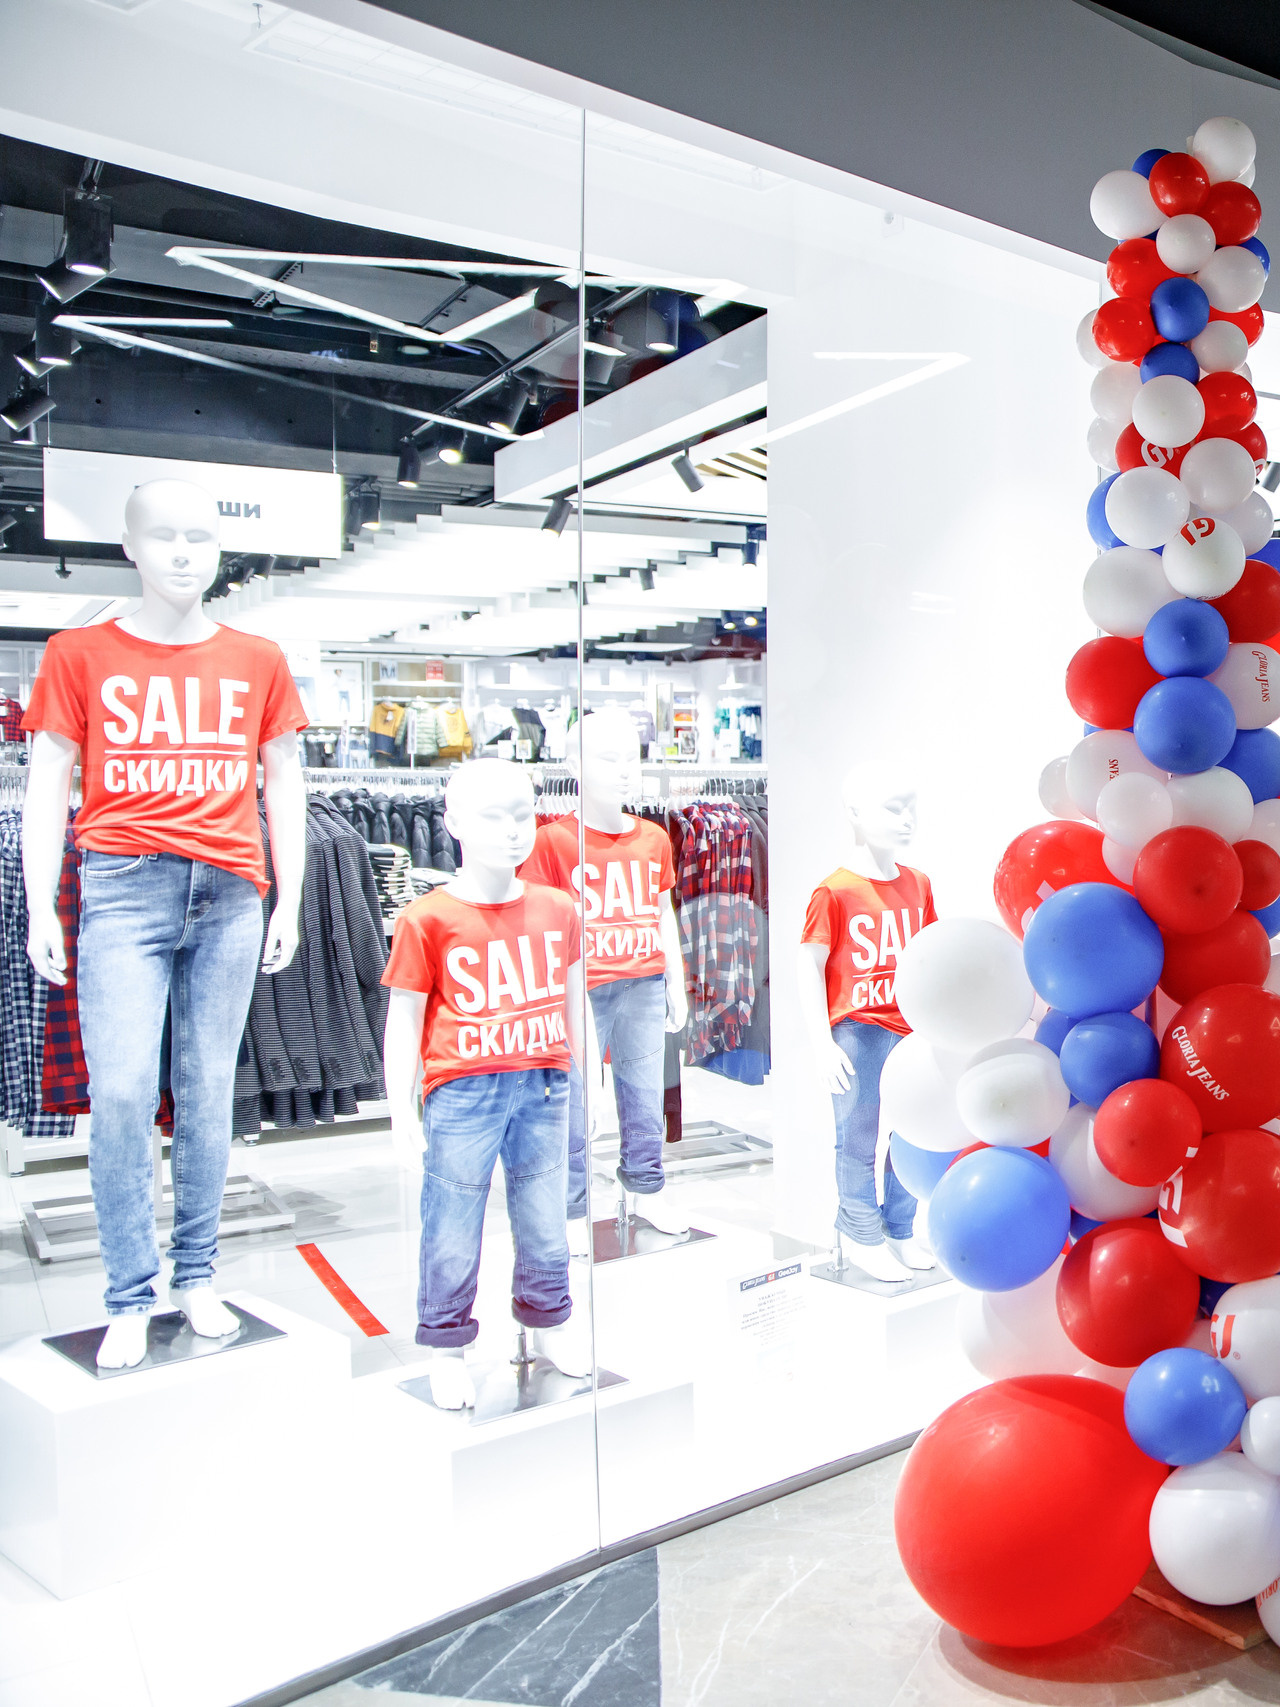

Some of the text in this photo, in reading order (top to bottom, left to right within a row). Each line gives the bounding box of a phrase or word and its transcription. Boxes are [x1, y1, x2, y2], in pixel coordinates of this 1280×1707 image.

[1251, 650, 1270, 702] GLORIA JEANS
[100, 674, 250, 747] SALE
[103, 758, 249, 798] СКИДКИ
[571, 860, 662, 920] SALE
[446, 930, 566, 1013] SALE
[1171, 1025, 1230, 1101] GLORIA JEANS
